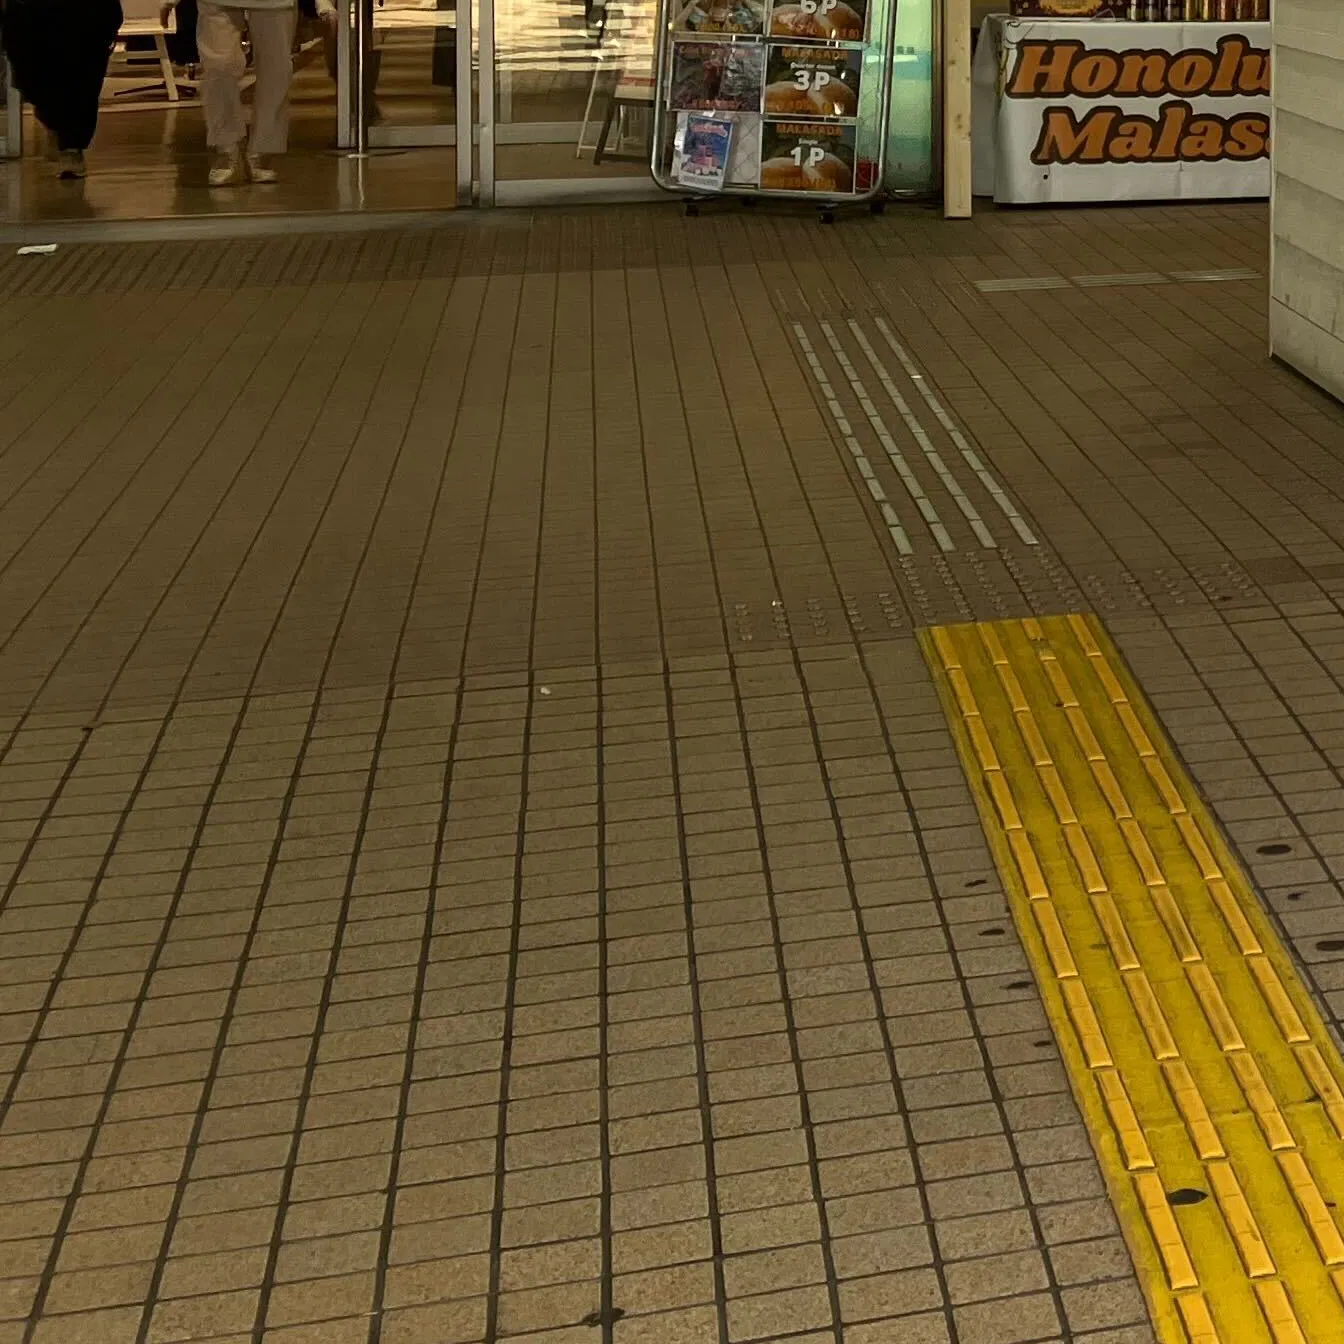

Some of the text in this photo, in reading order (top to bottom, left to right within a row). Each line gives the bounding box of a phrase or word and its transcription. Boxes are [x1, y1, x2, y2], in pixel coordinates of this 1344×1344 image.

[793, 70, 830, 91] 3P
[1031, 101, 1270, 166] Malas
[790, 146, 825, 167] 1P
